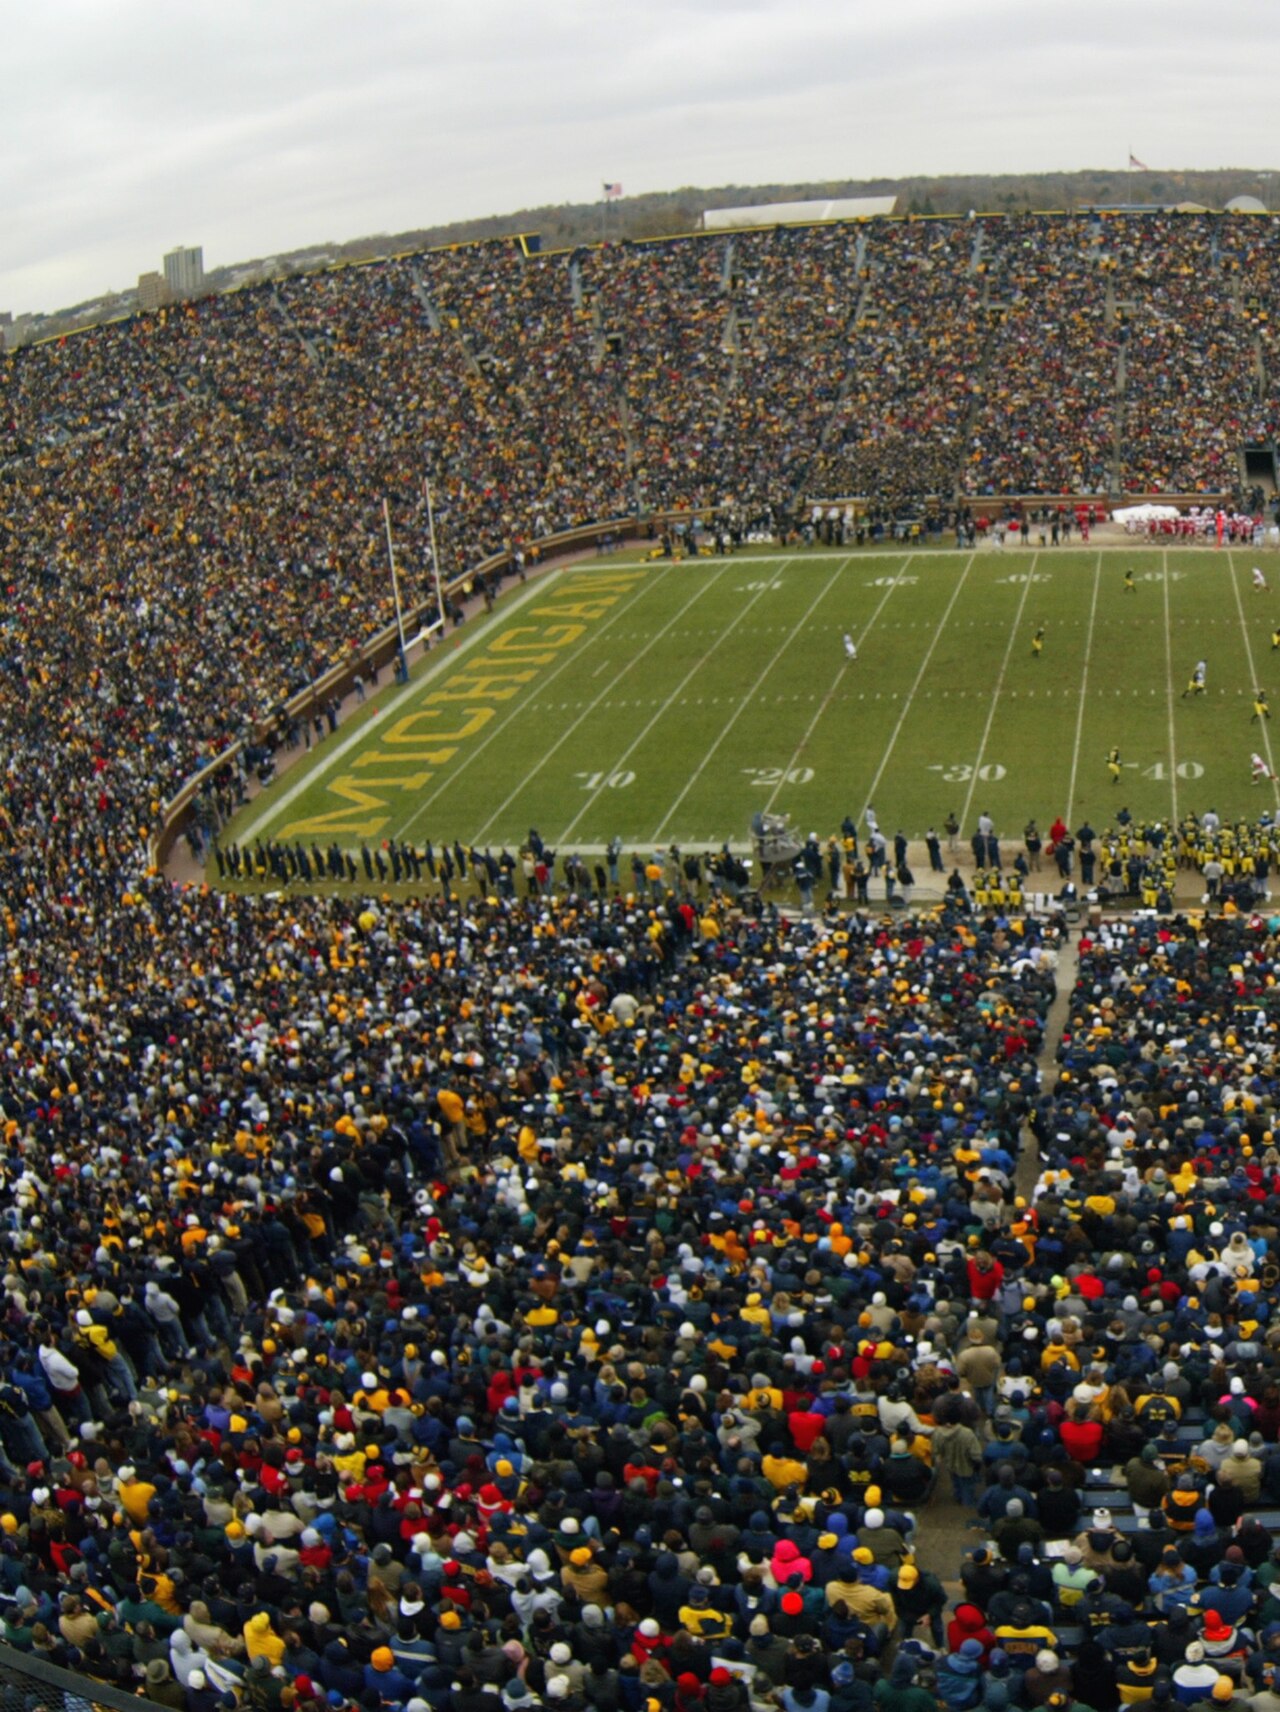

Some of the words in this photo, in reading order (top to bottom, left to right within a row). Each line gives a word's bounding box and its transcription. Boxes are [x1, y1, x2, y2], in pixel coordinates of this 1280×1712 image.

[275, 571, 649, 839] MICHIGAN
[751, 768, 816, 786] 20
[943, 764, 1007, 782] 30
[1140, 762, 1204, 780] 40
[580, 771, 637, 790] 10
